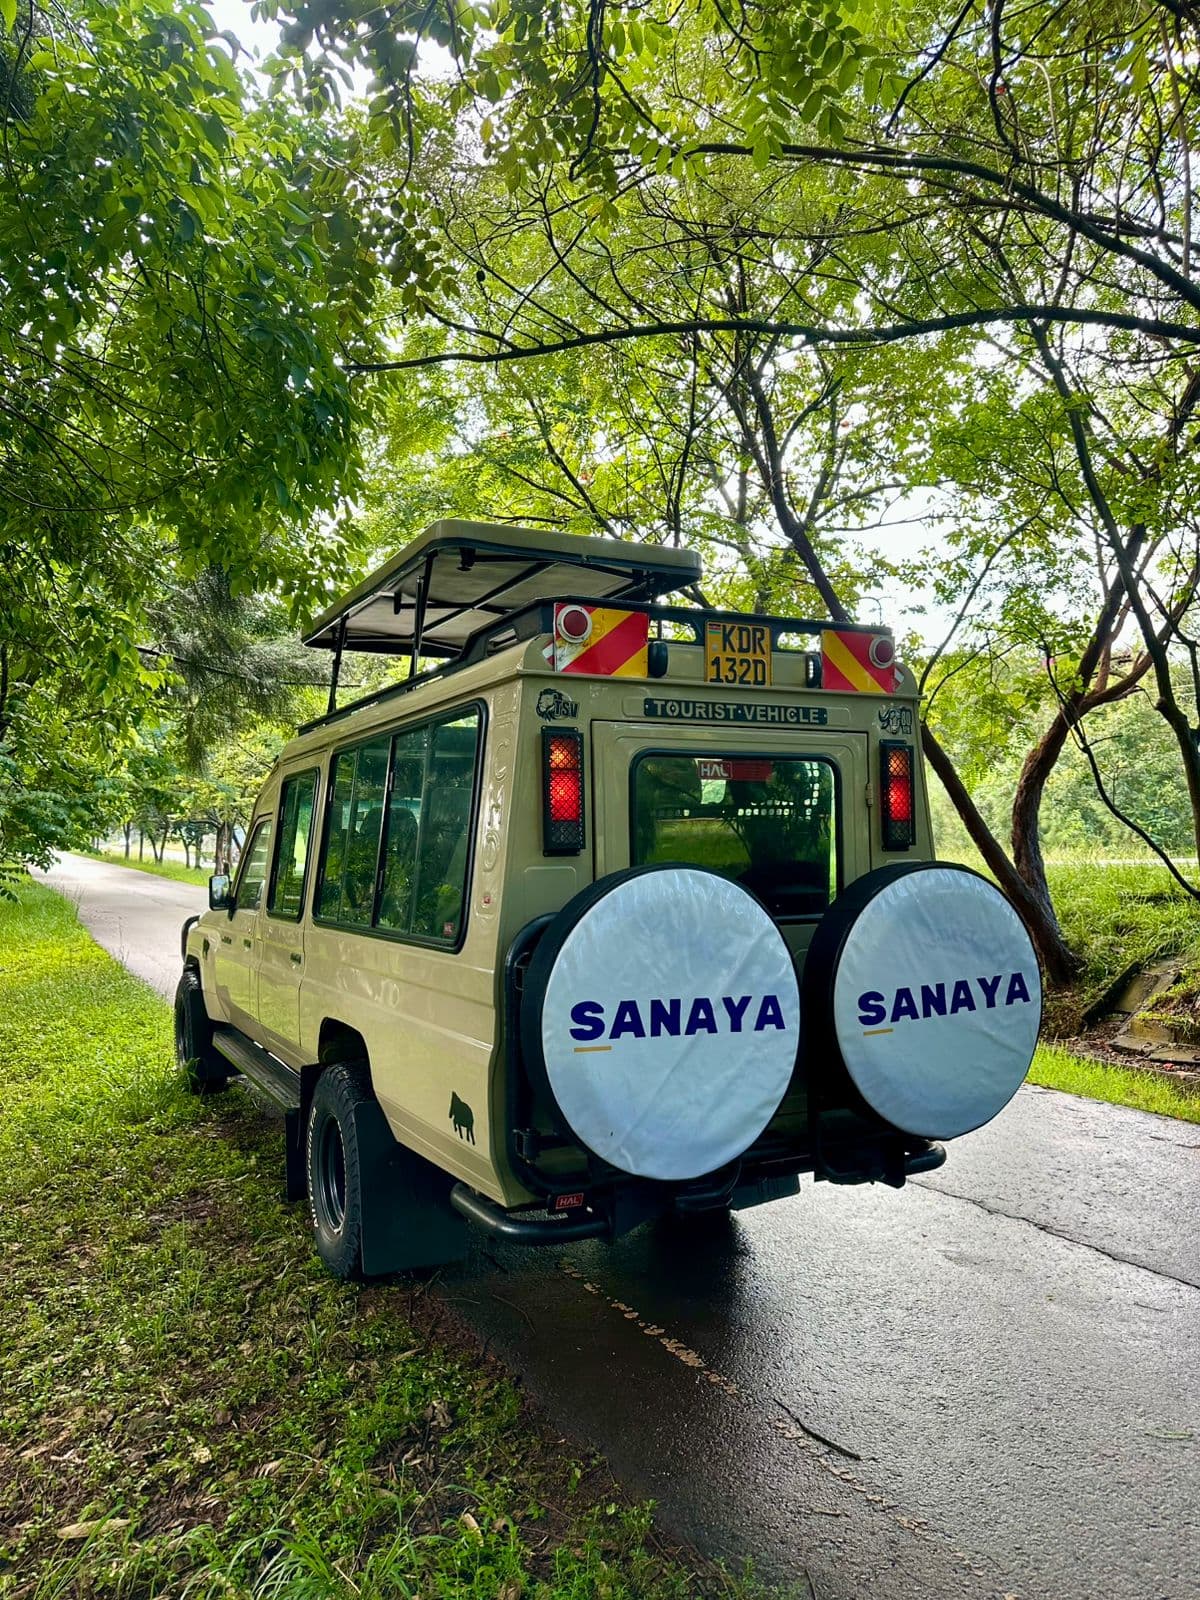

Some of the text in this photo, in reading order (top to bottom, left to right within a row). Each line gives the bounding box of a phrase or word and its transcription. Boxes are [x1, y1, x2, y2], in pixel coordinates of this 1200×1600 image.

[722, 625, 766, 655] KDR
[709, 656, 766, 686] 132D
[653, 700, 820, 724] TOURIST VEHICLE
[700, 763, 729, 777] HAL
[857, 972, 1031, 1026] SANAYA
[569, 995, 786, 1041] SANAYA
[559, 1196, 580, 1206] HAL
